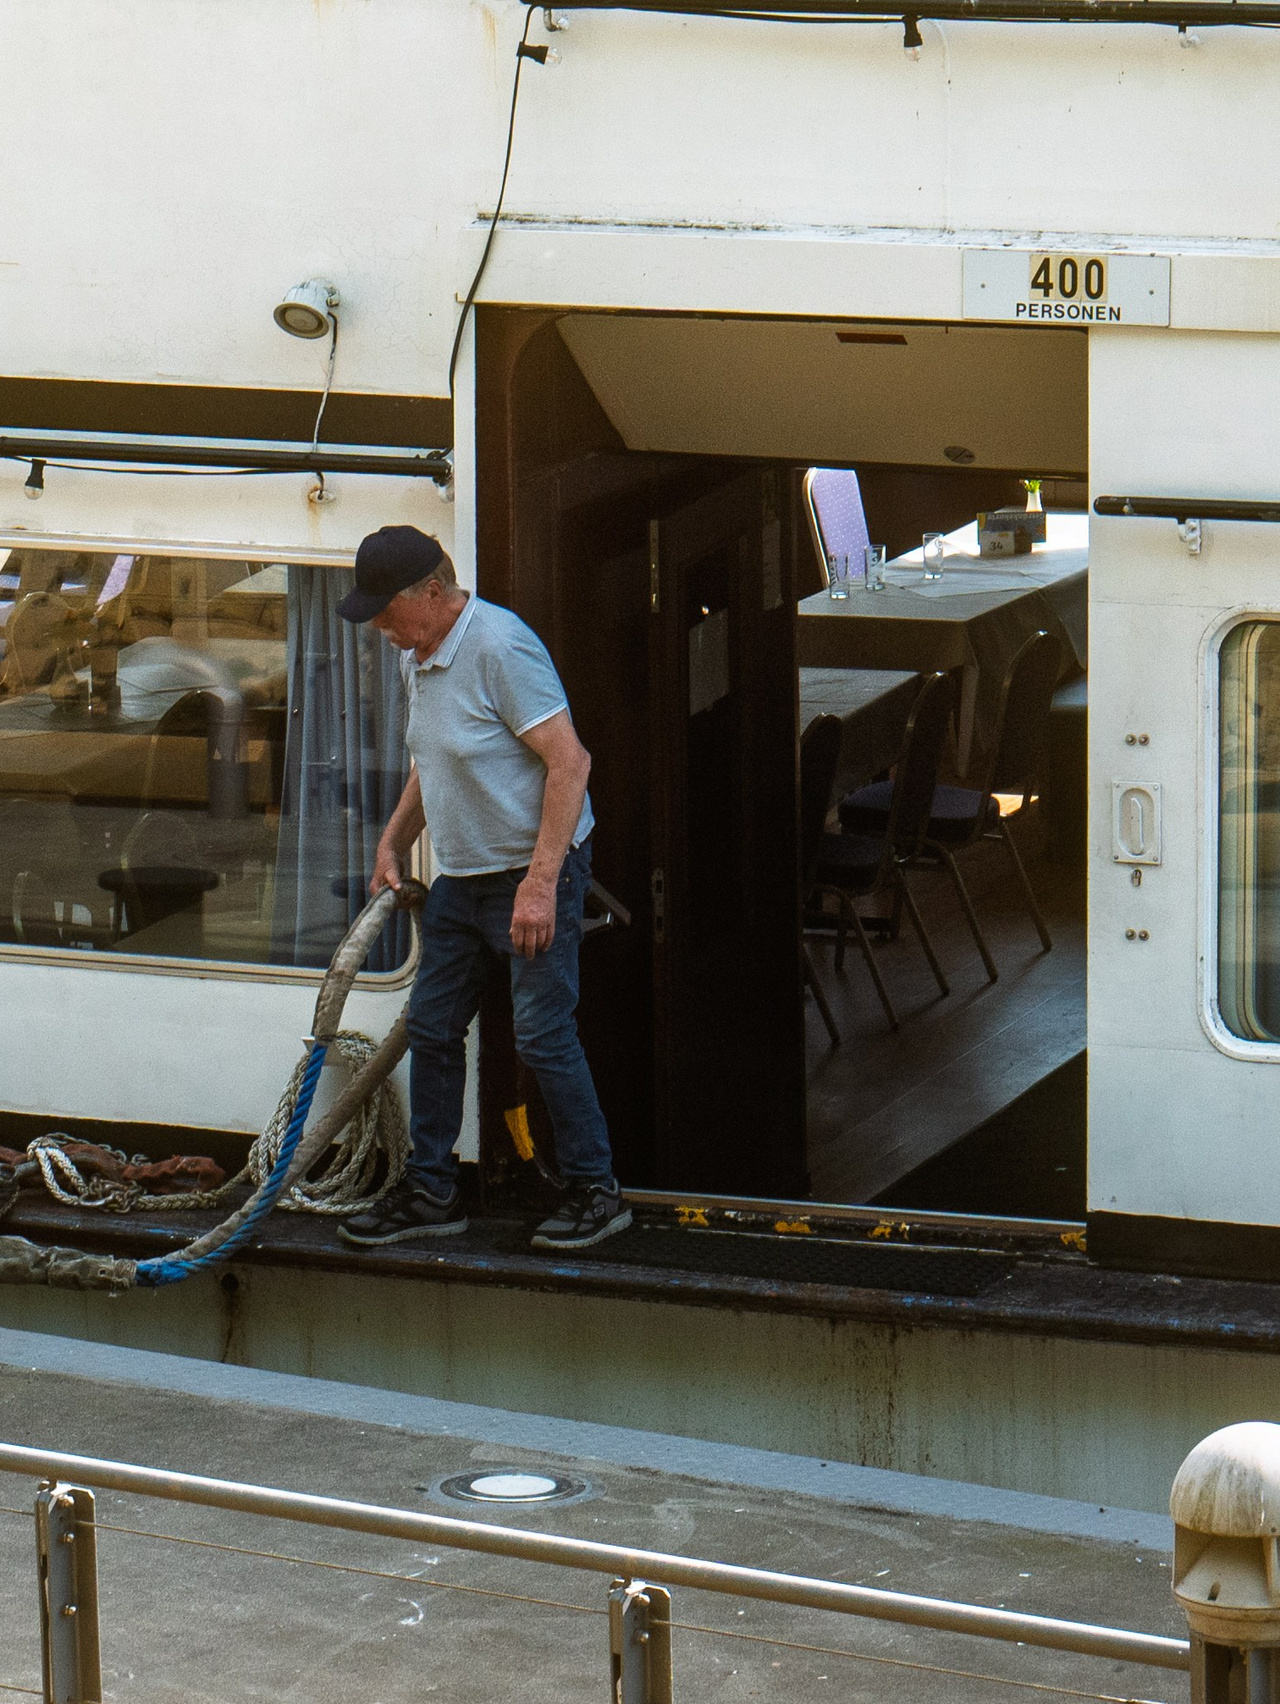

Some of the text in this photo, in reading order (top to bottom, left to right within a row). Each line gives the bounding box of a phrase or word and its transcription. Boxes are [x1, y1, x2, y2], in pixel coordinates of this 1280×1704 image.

[1031, 257, 1104, 299] 400
[1016, 303, 1120, 321] PERSONEN
[990, 541, 1003, 551] 34
